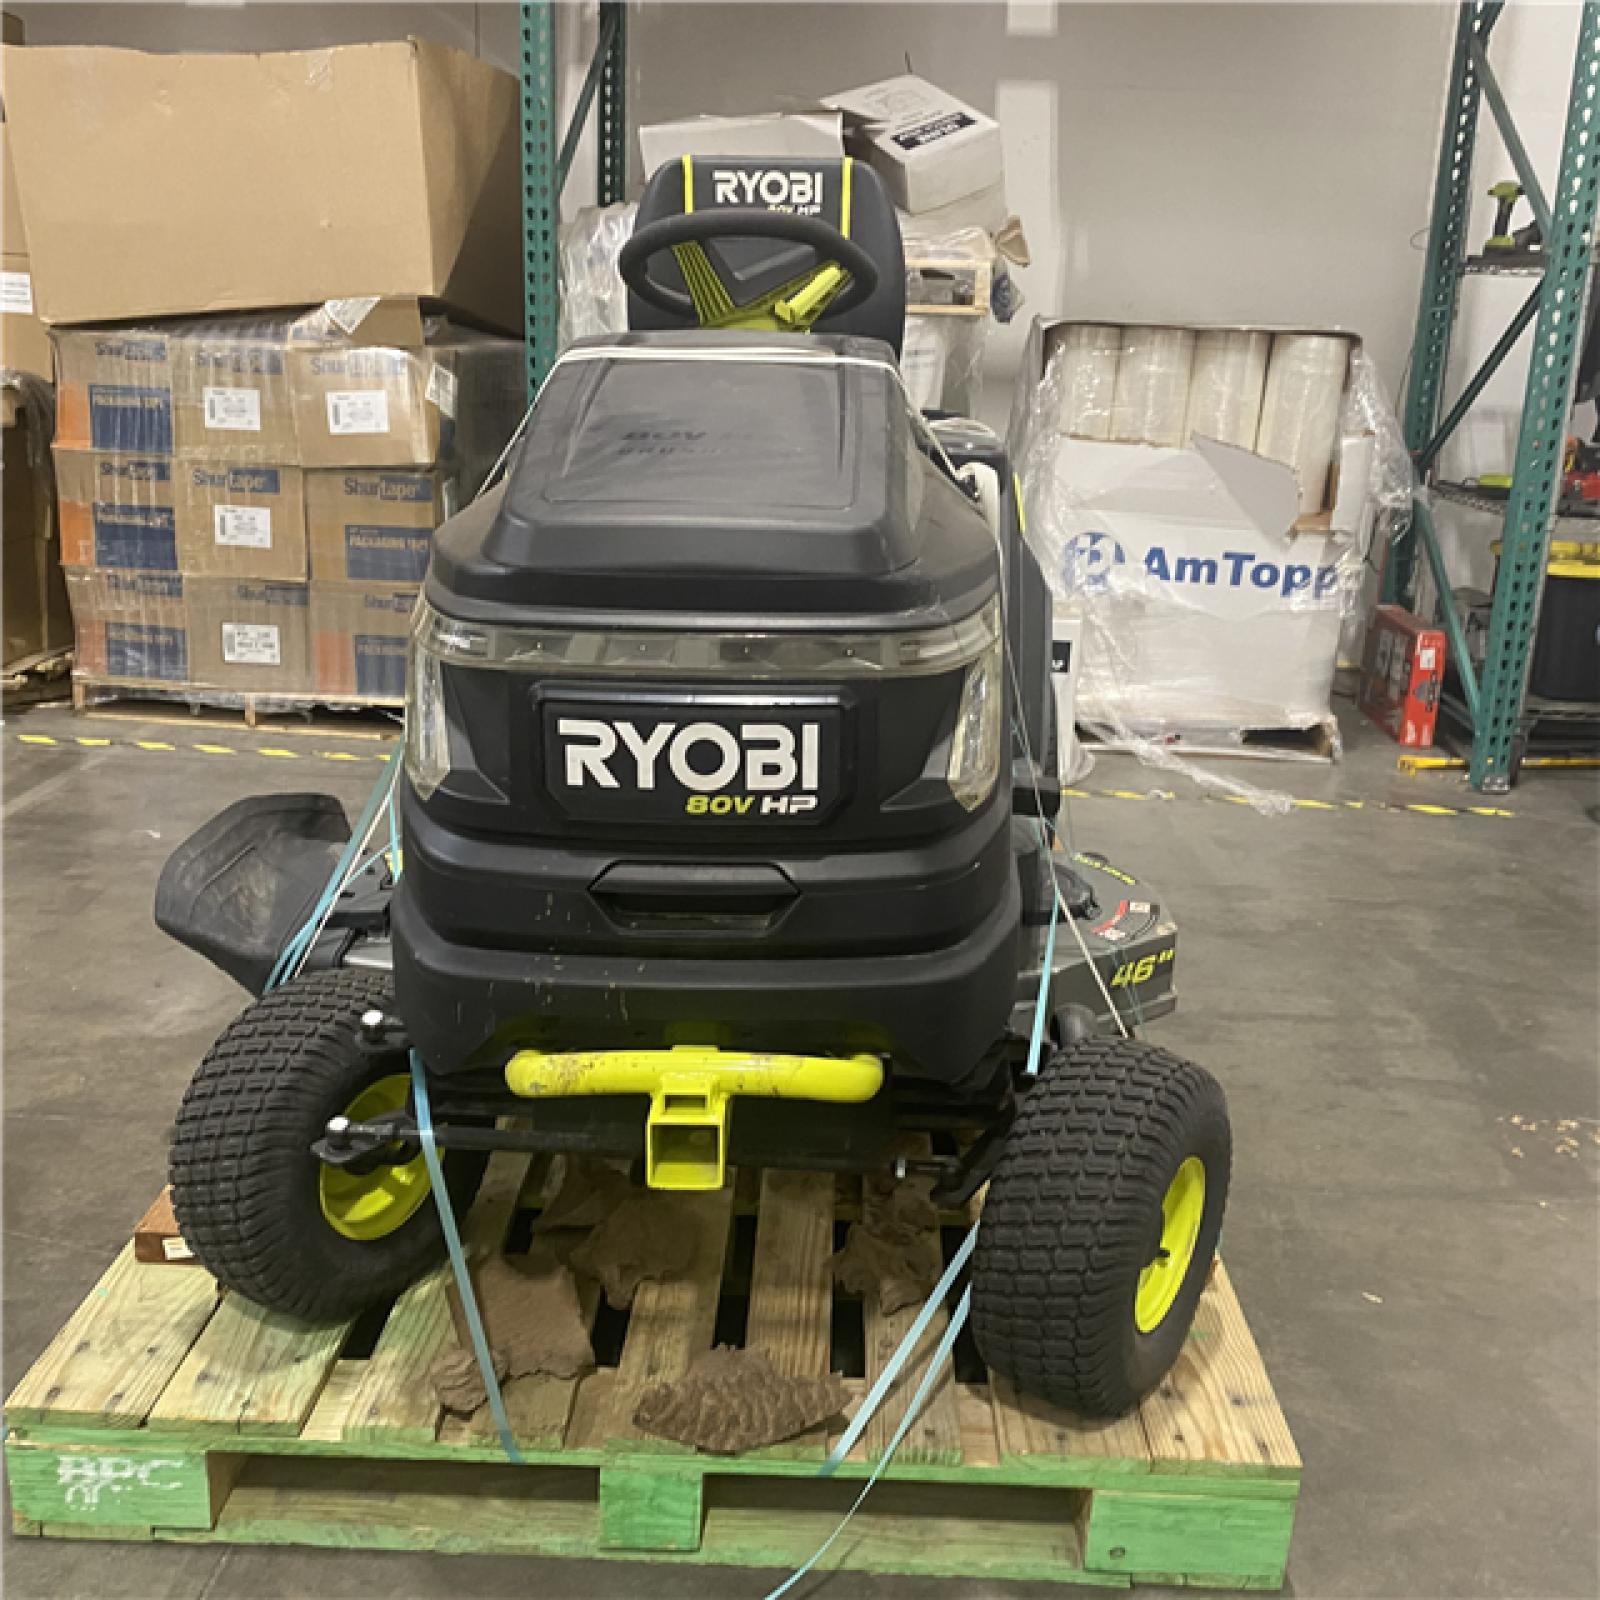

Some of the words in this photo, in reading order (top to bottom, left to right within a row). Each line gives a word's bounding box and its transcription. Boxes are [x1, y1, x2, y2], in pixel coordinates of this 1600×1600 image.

[712, 169, 823, 204] RYOBI
[192, 468, 266, 493] Shurtape
[344, 476, 419, 501] Shurtape
[1144, 547, 1337, 599] AmTopp
[557, 718, 819, 791] RYOBI
[685, 795, 755, 815] 80V
[759, 795, 819, 815] HP
